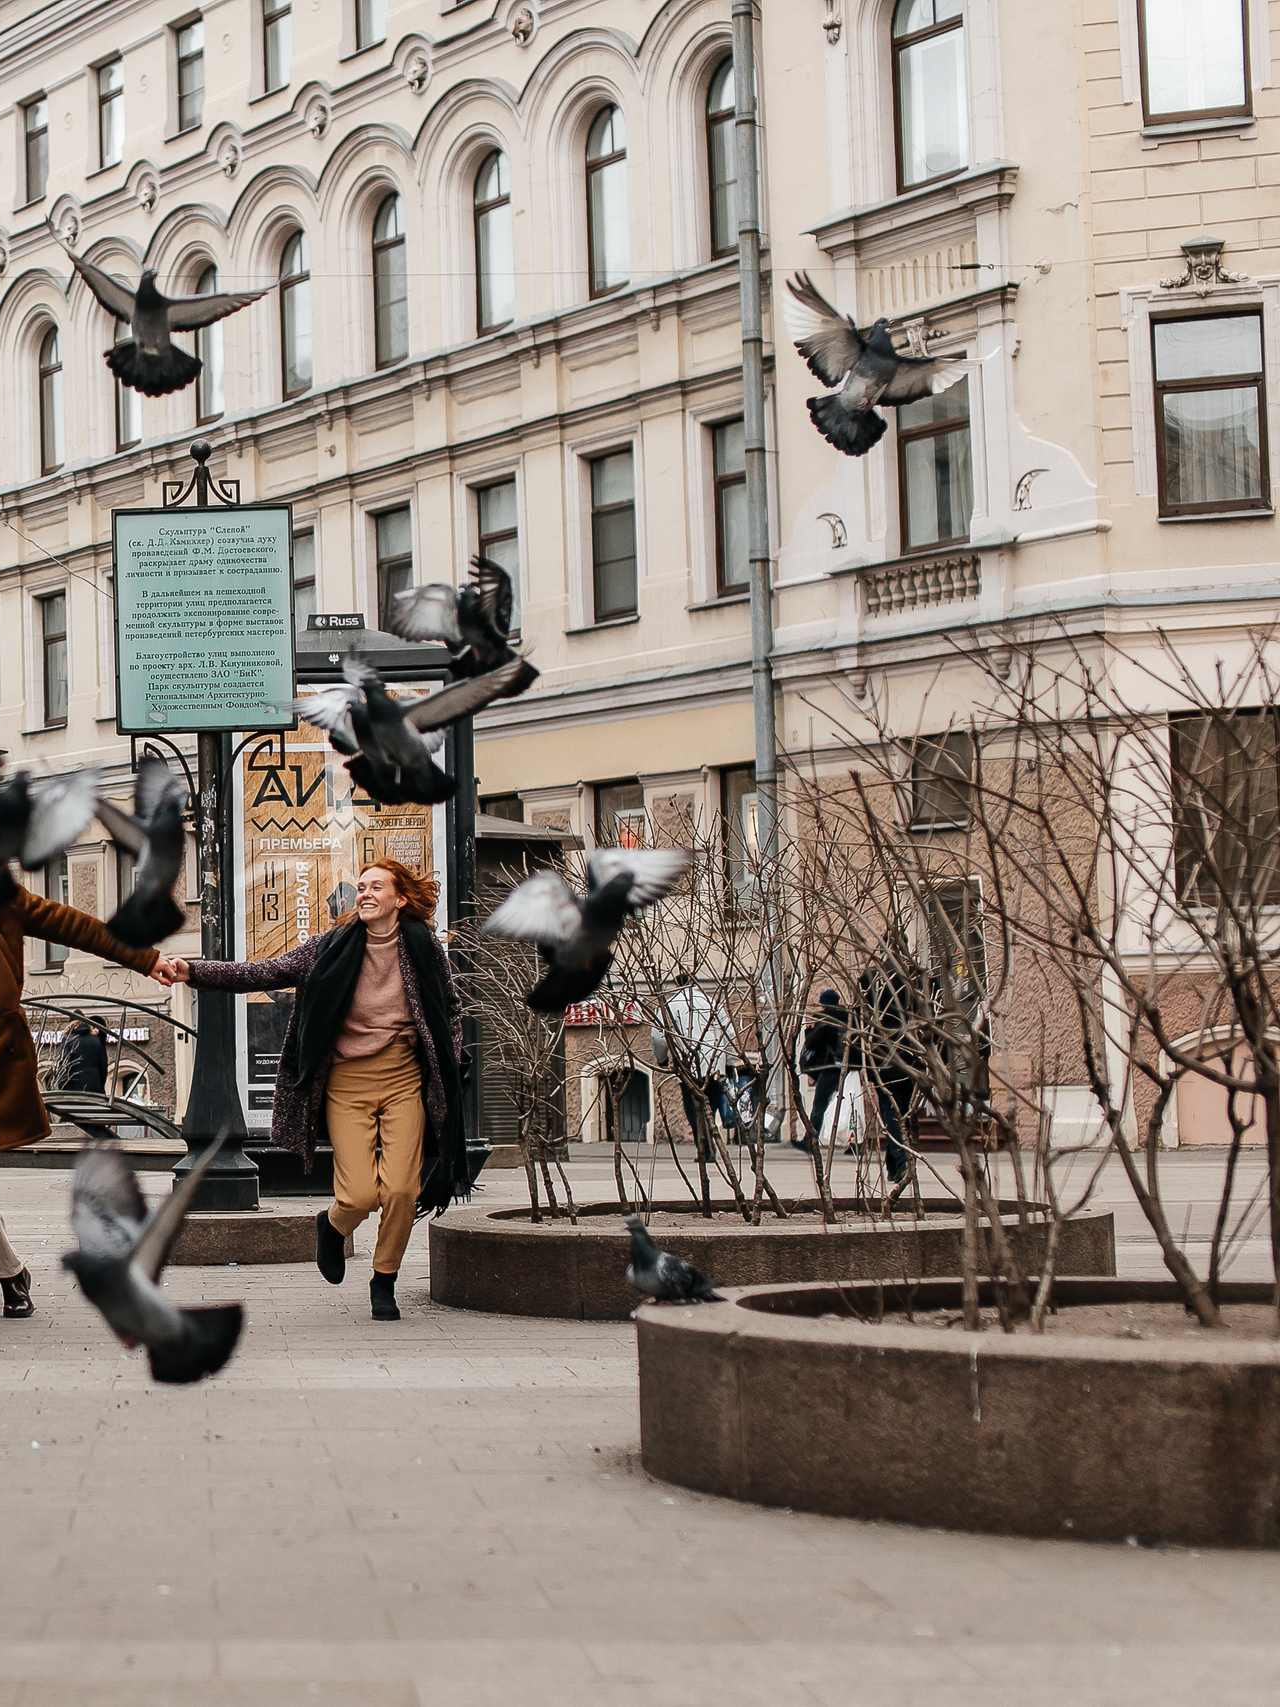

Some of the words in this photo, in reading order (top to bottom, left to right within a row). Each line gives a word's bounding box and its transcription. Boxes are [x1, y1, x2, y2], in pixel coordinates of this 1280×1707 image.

[158, 527, 207, 537] Скульптура
[128, 540, 144, 548] (ск.
[217, 537, 255, 545] созвучна
[257, 536, 277, 544] духу
[131, 548, 189, 558] произведений
[192, 547, 215, 555] Ф.М.
[217, 546, 277, 555] Достоевского,
[139, 560, 187, 569] раскрывает
[188, 559, 214, 567] драму
[216, 557, 268, 565] одиночества
[173, 569, 217, 578] призывает
[226, 567, 283, 575] состраданию.
[142, 590, 148, 598] В
[151, 589, 201, 598] дальнейшем
[216, 587, 266, 596] пешеходной
[136, 601, 183, 610] территории
[185, 600, 205, 608] улиц
[208, 598, 272, 607] предполагается
[131, 611, 181, 620] продолжить
[183, 609, 251, 618] экспонирование
[252, 608, 280, 617] совре-
[125, 621, 155, 630] менной
[157, 620, 207, 630] скульптуры
[216, 619, 243, 628] форме
[245, 618, 284, 626] выставок
[329, 616, 360, 627] Russ
[125, 631, 182, 641] произведений
[184, 629, 245, 639] петербургских
[246, 629, 287, 637] мастеров.
[136, 651, 205, 660] Благоустройство
[208, 651, 227, 659] улиц
[142, 663, 175, 671] проекту
[178, 663, 196, 671] арх.
[198, 660, 218, 668] Л.В.
[150, 672, 208, 681] осуществлено
[211, 670, 231, 678] ЗАО
[148, 683, 170, 692] Парк
[172, 682, 220, 691] скульптуры
[223, 681, 265, 689] создается
[145, 692, 205, 701] Региональным
[206, 691, 269, 700] Архитектурно-
[151, 702, 223, 712] Художественным
[225, 701, 263, 709] Фондом.
[368, 817, 404, 828] ДЖУЗЕППЕ
[405, 816, 426, 827] ВЕРДИ
[259, 837, 343, 851] ПРЕМЬЕРА
[264, 860, 275, 889] 11
[261, 893, 279, 922] 13
[295, 861, 310, 945] ФЕВРАЛЯ
